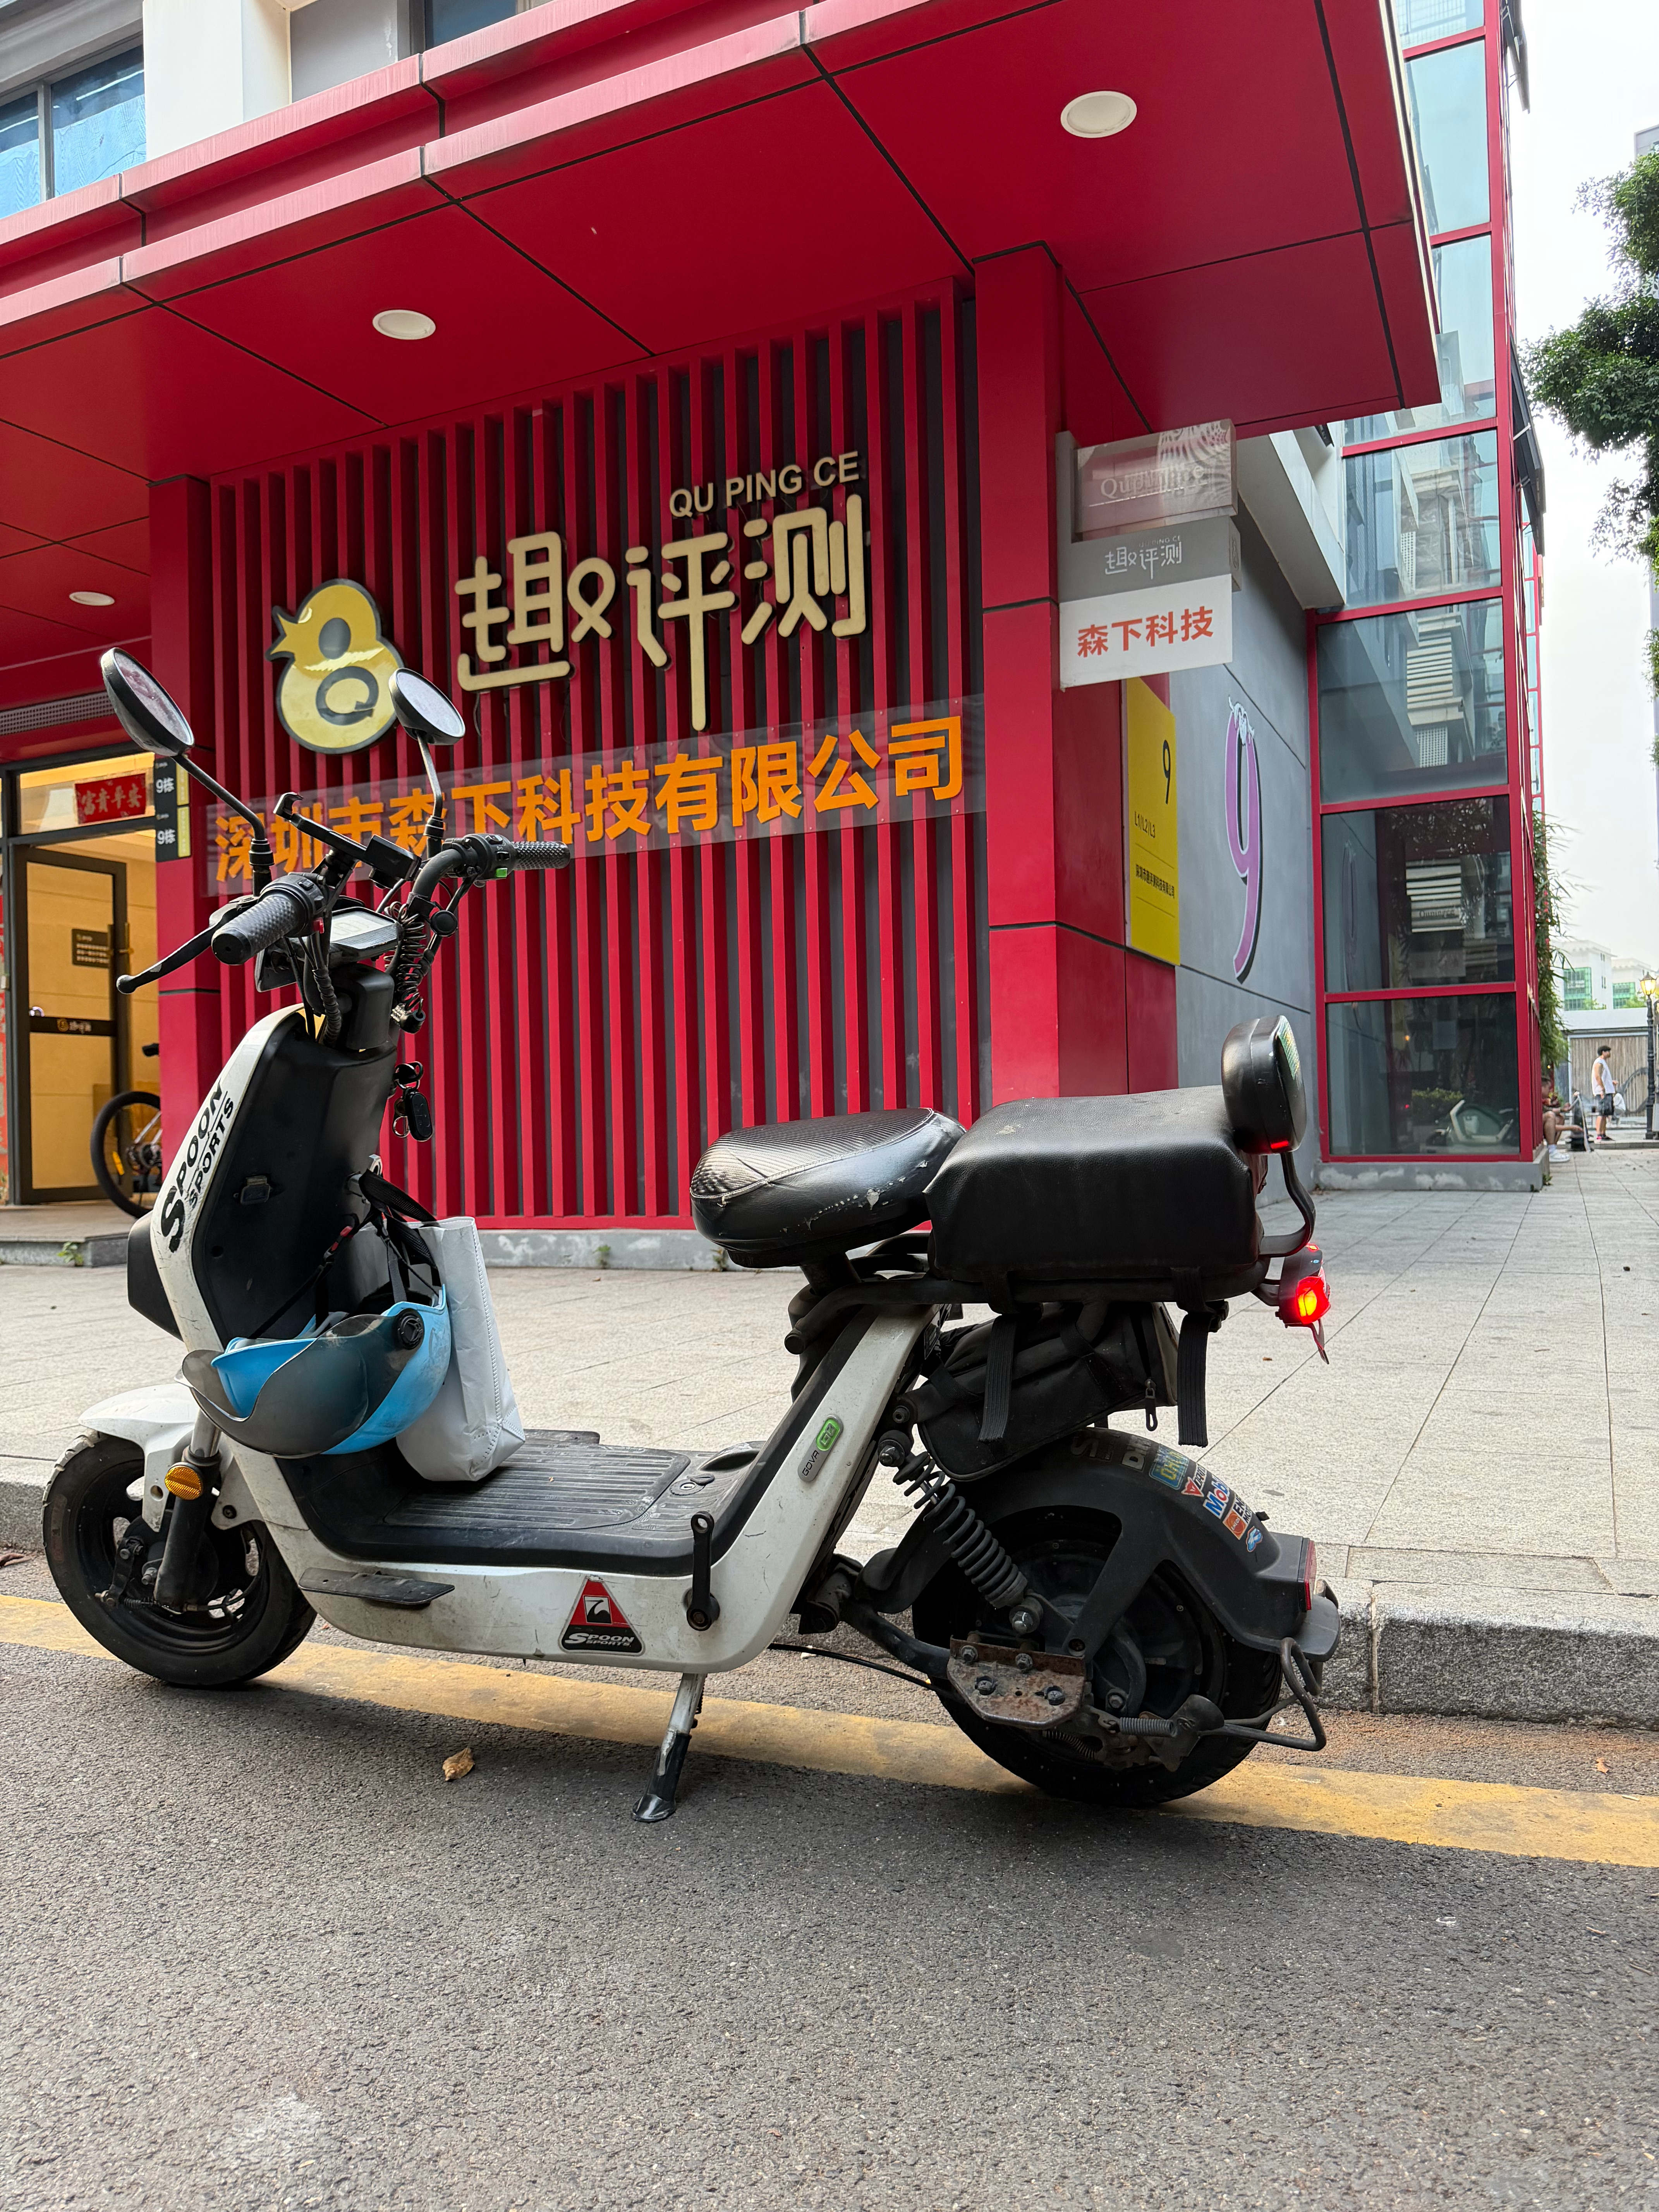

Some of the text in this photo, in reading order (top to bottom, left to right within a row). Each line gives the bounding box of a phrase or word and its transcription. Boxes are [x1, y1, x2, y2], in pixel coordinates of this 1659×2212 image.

[670, 451, 859, 517] QU PING CE
[1105, 542, 1182, 580] 趣评测
[455, 494, 866, 731] 趣评测
[1077, 606, 1214, 658] 森下科技
[215, 716, 962, 881] 深圳市森下科技有限公司
[1163, 740, 1171, 805] 9
[1135, 811, 1156, 838] L1/L2/L3
[160, 1077, 223, 1253] SPOON
[188, 1097, 234, 1209] SPORTS
[802, 1450, 820, 1476] GOVA
[565, 1633, 635, 1644] SPOON
